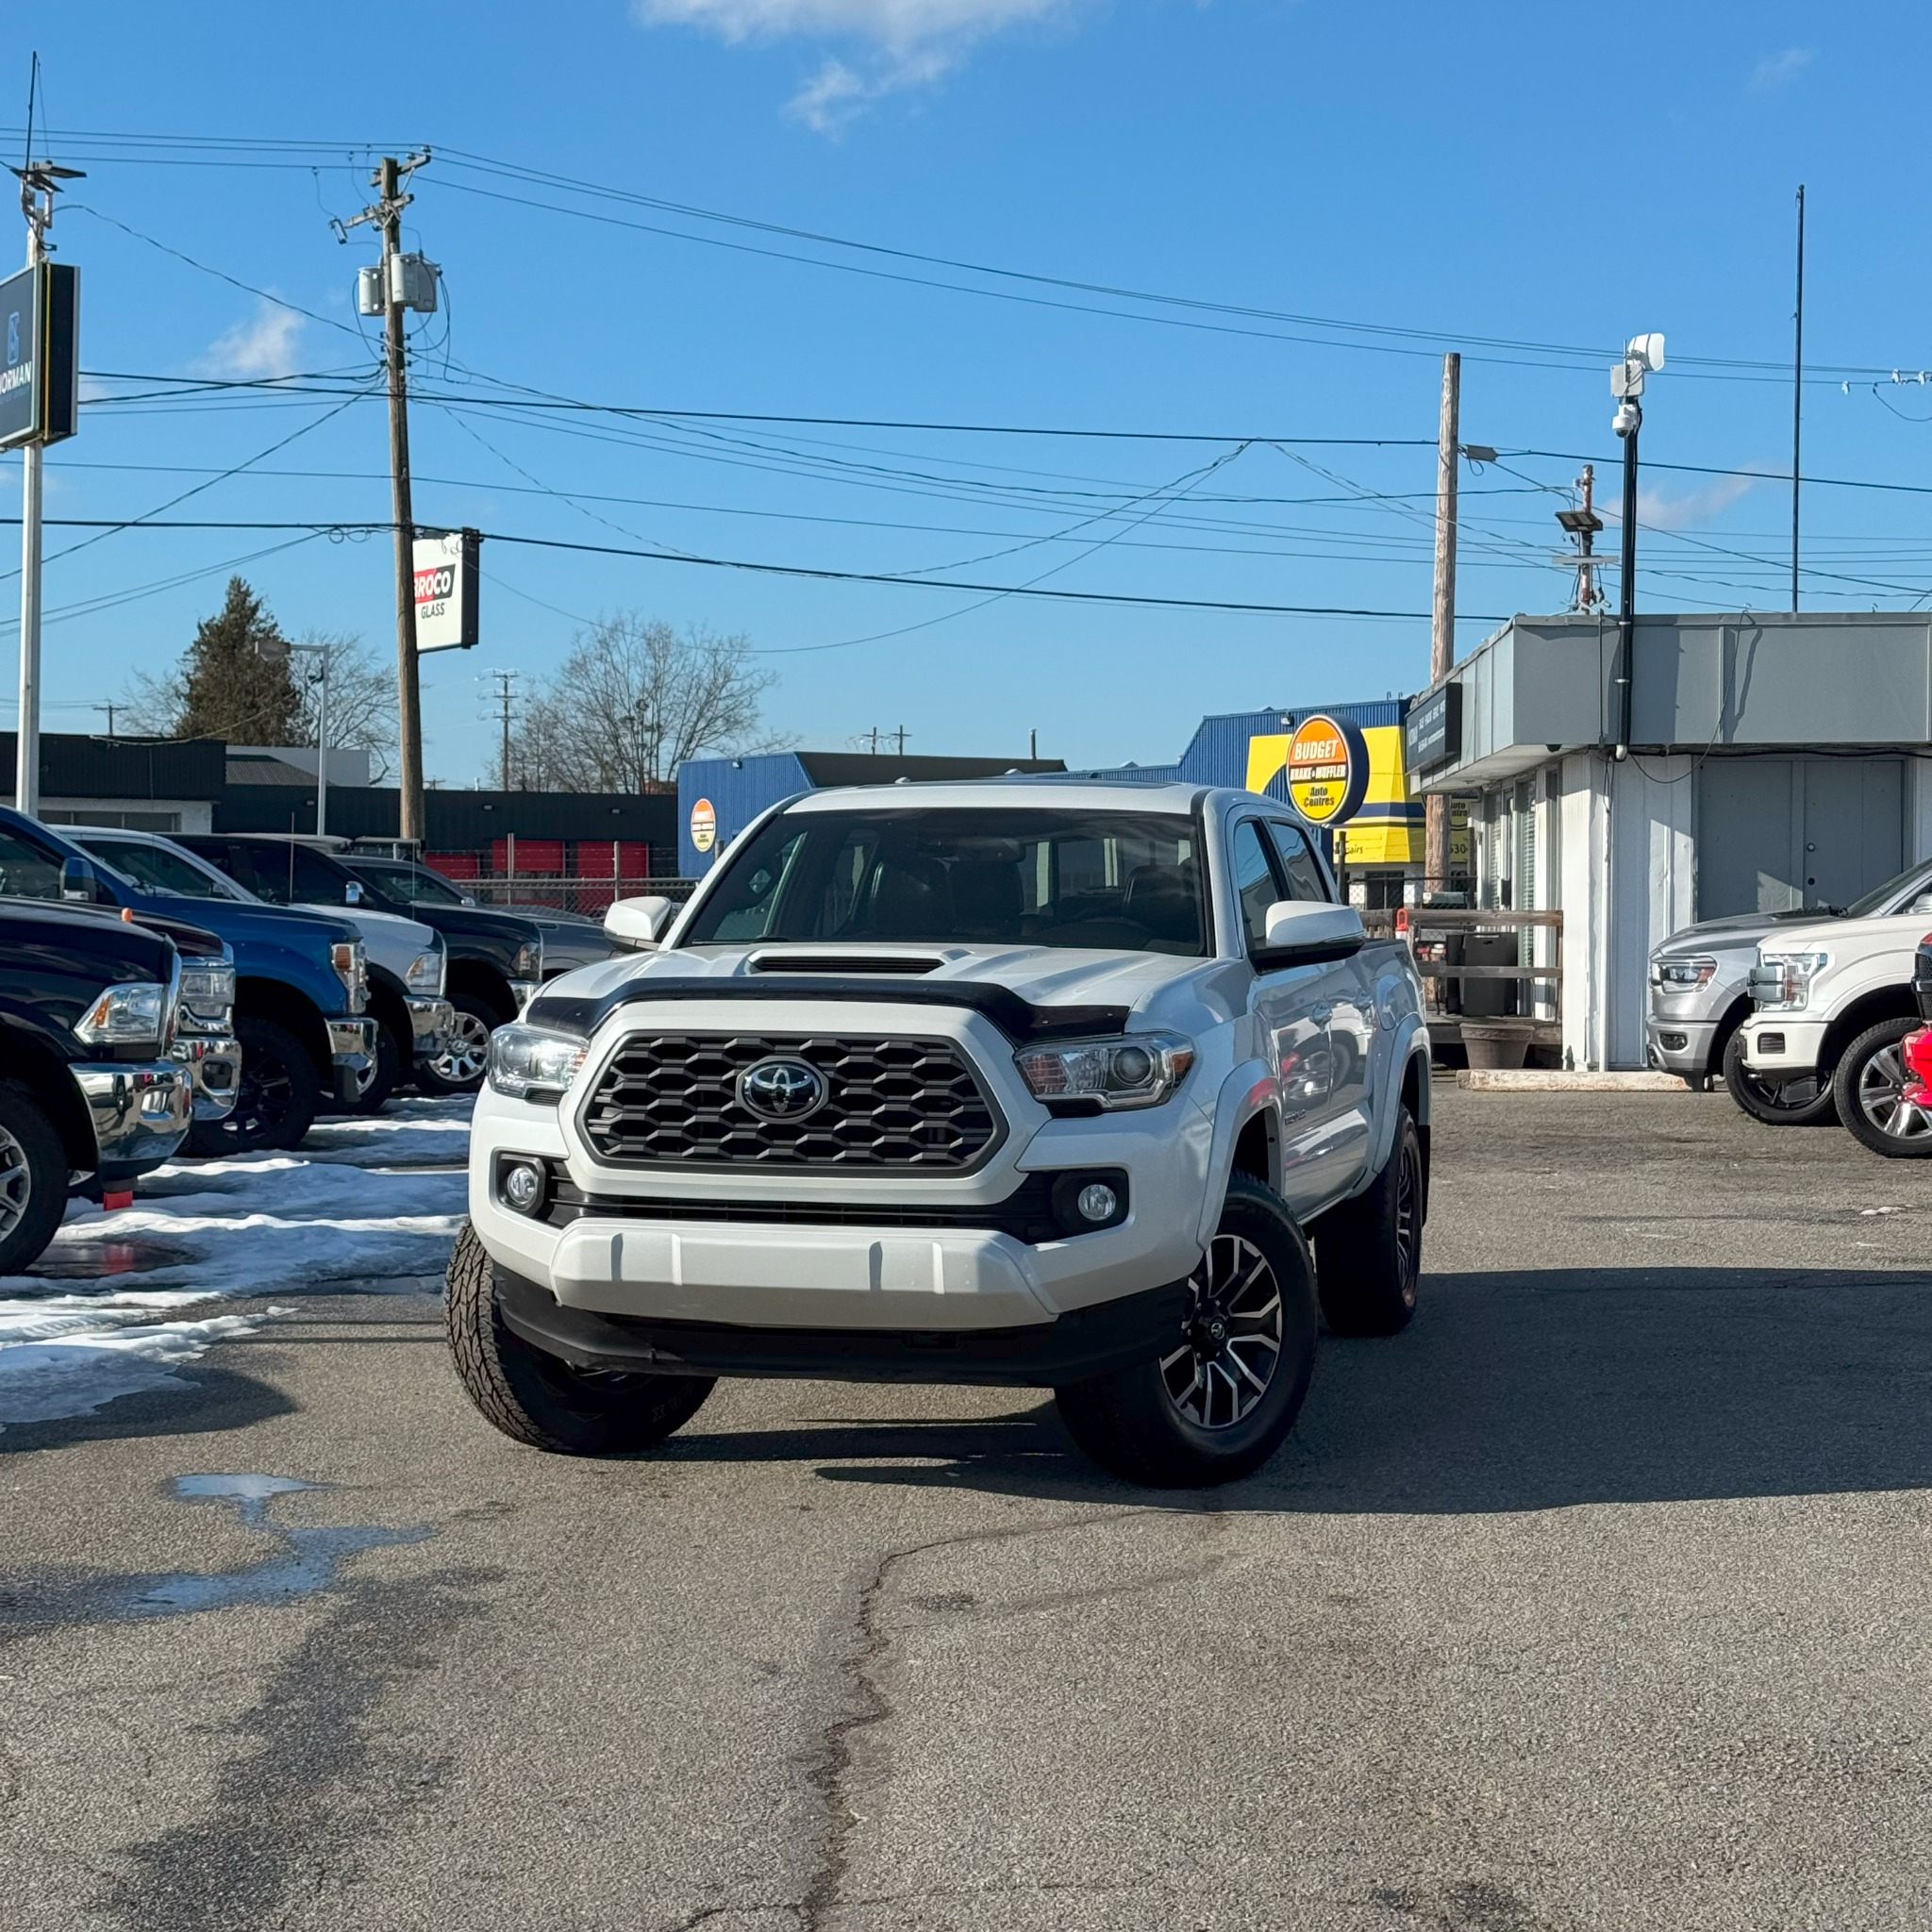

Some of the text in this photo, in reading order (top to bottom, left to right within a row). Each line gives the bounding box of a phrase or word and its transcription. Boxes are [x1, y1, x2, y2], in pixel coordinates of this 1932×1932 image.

[0, 361, 31, 395] ORMAN
[421, 602, 445, 619] GLASS
[1293, 740, 1339, 761] BUDGET
[1290, 767, 1311, 781] BRAKE
[1316, 764, 1346, 779] MUFFLER
[1309, 787, 1328, 797] Auto
[1304, 796, 1335, 808] Centres
